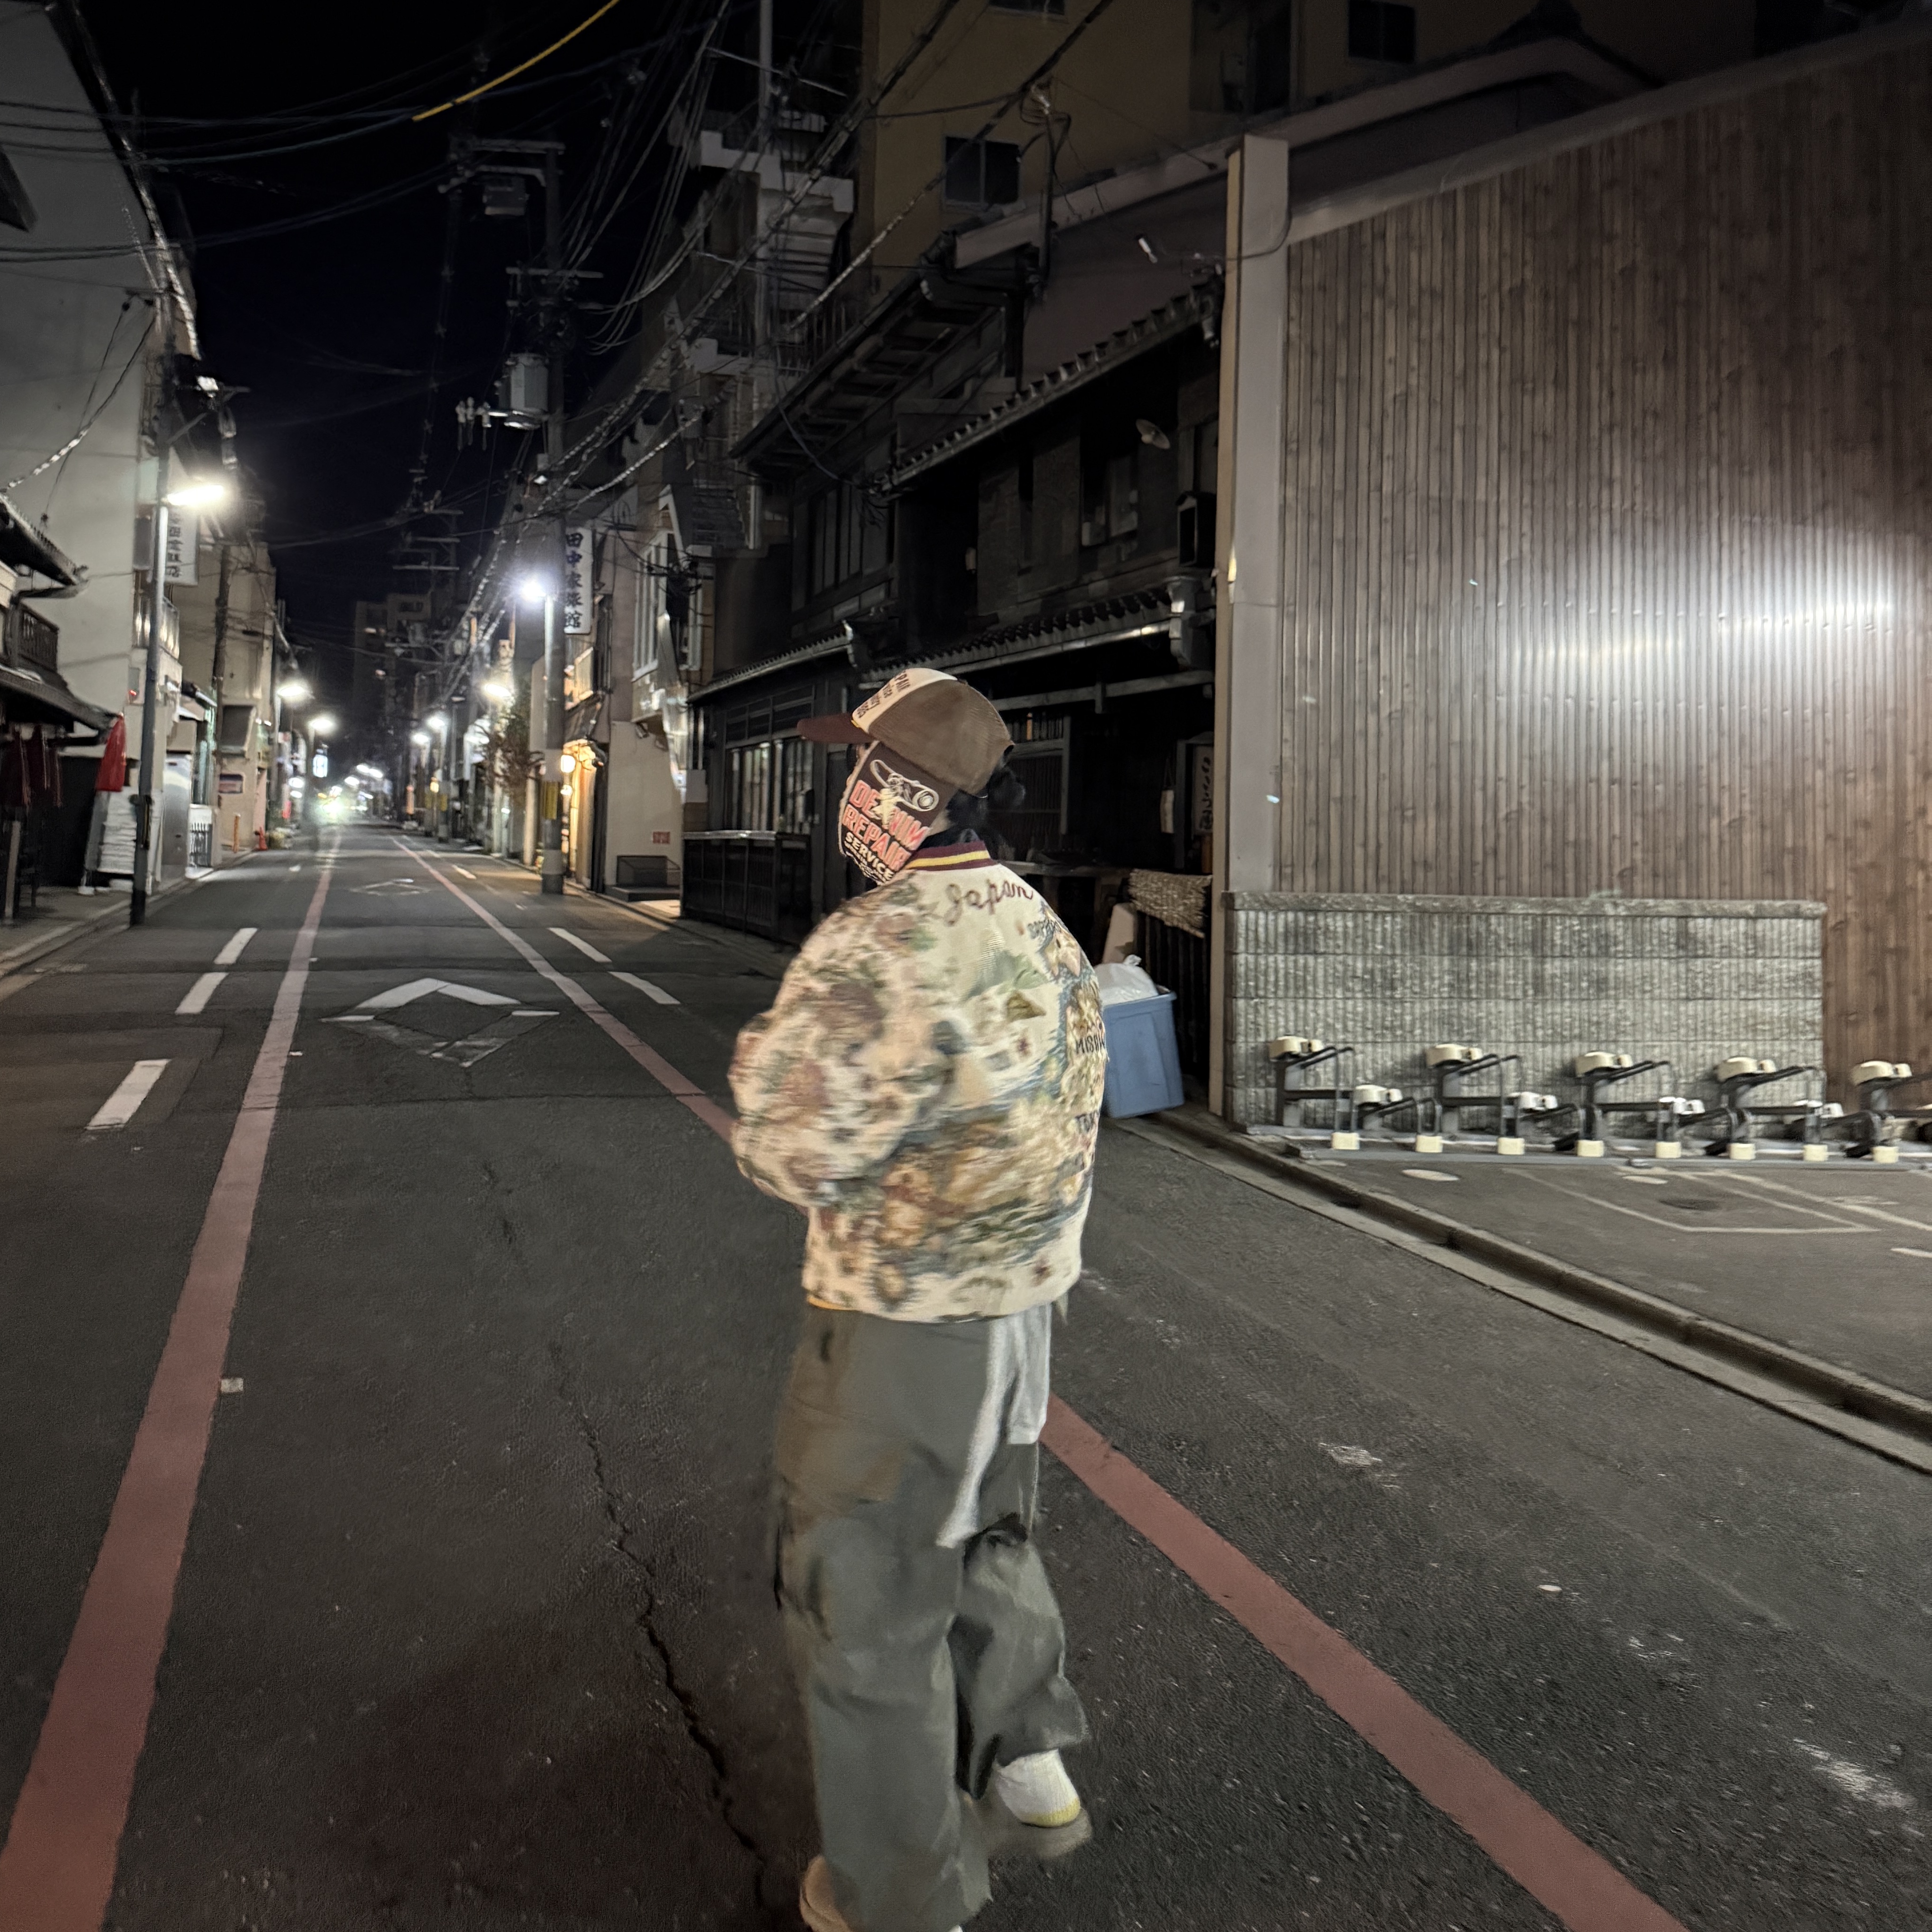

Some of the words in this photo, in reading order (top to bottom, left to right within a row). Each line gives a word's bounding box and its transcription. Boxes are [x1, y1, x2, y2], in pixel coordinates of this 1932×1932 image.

[842, 804, 912, 871] REPAIR
[845, 832, 894, 881] SERVICE
[943, 878, 1033, 927] Japan
